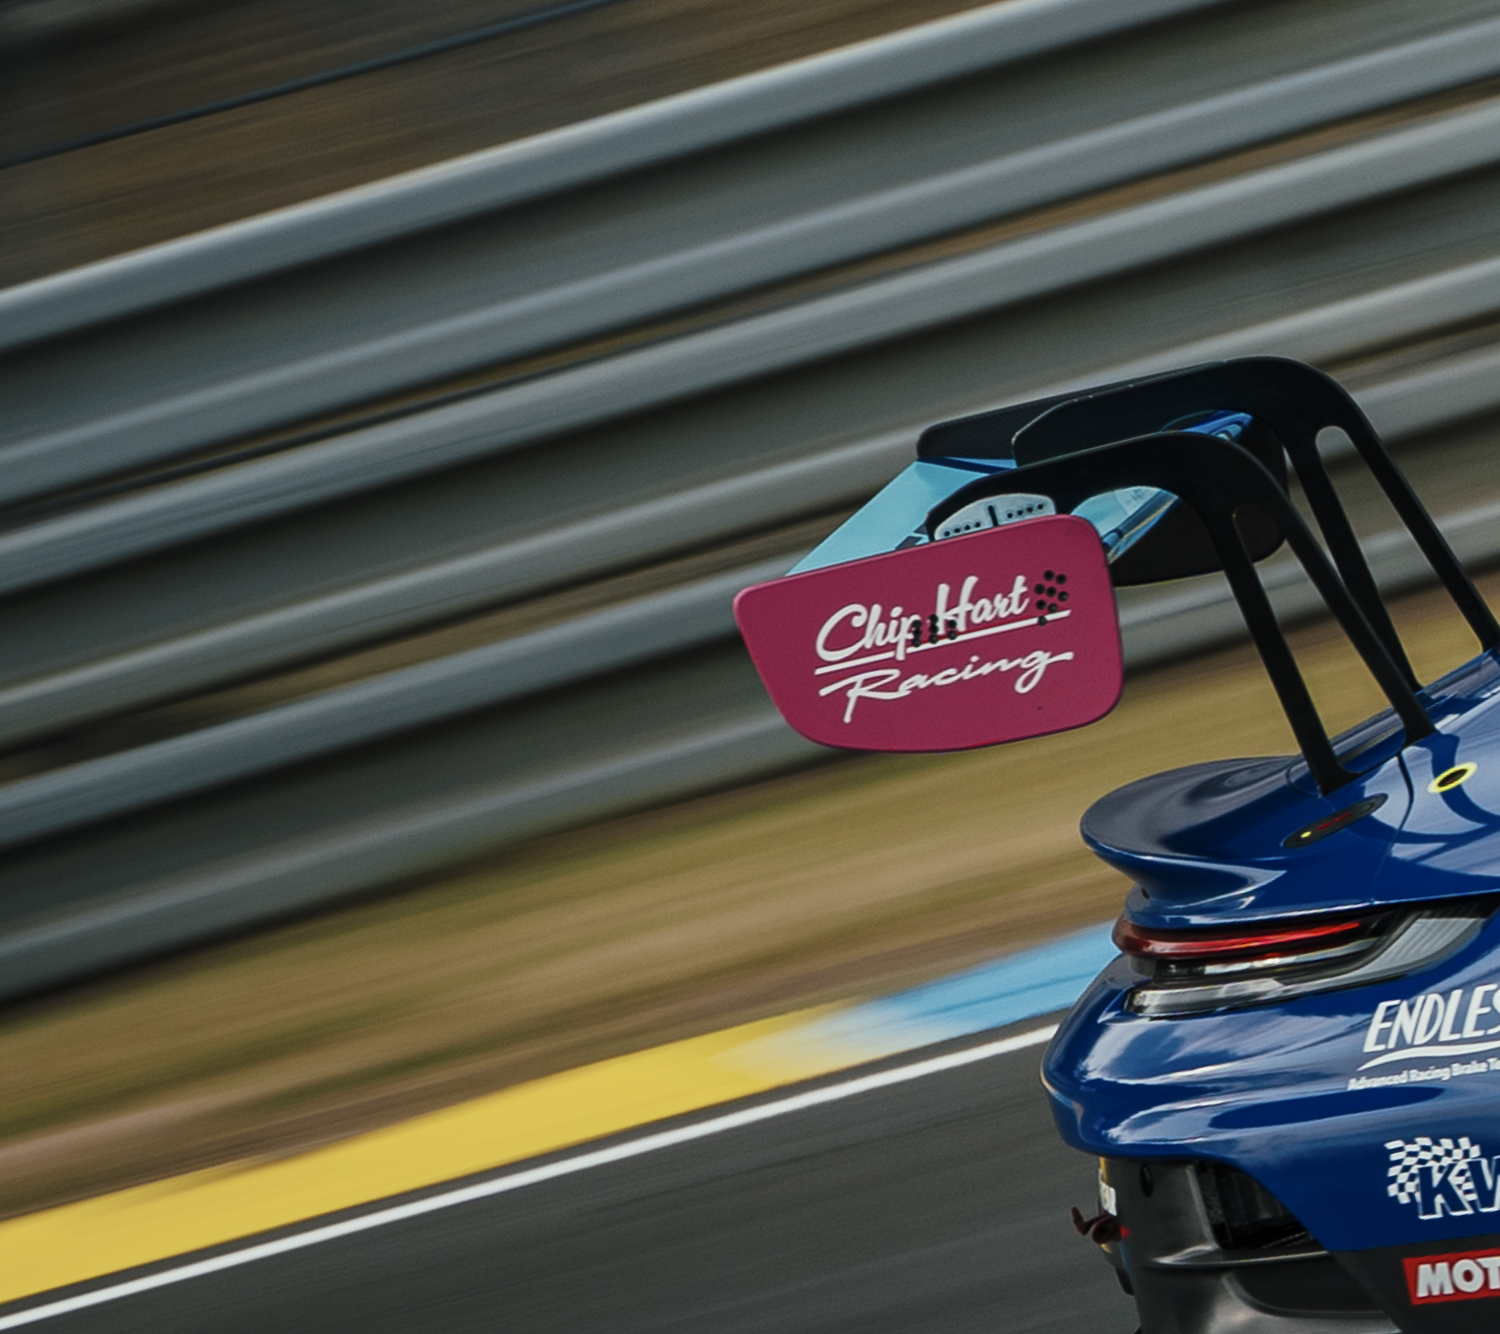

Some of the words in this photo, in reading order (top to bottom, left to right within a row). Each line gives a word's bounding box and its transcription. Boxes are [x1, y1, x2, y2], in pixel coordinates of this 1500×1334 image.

[815, 601, 922, 661] Chip
[922, 575, 1030, 642] Hart
[818, 650, 1074, 723] Racing
[1347, 1070, 1408, 1091] Advanced
[1409, 1066, 1451, 1080] Racing
[1452, 1059, 1488, 1076] Brake
